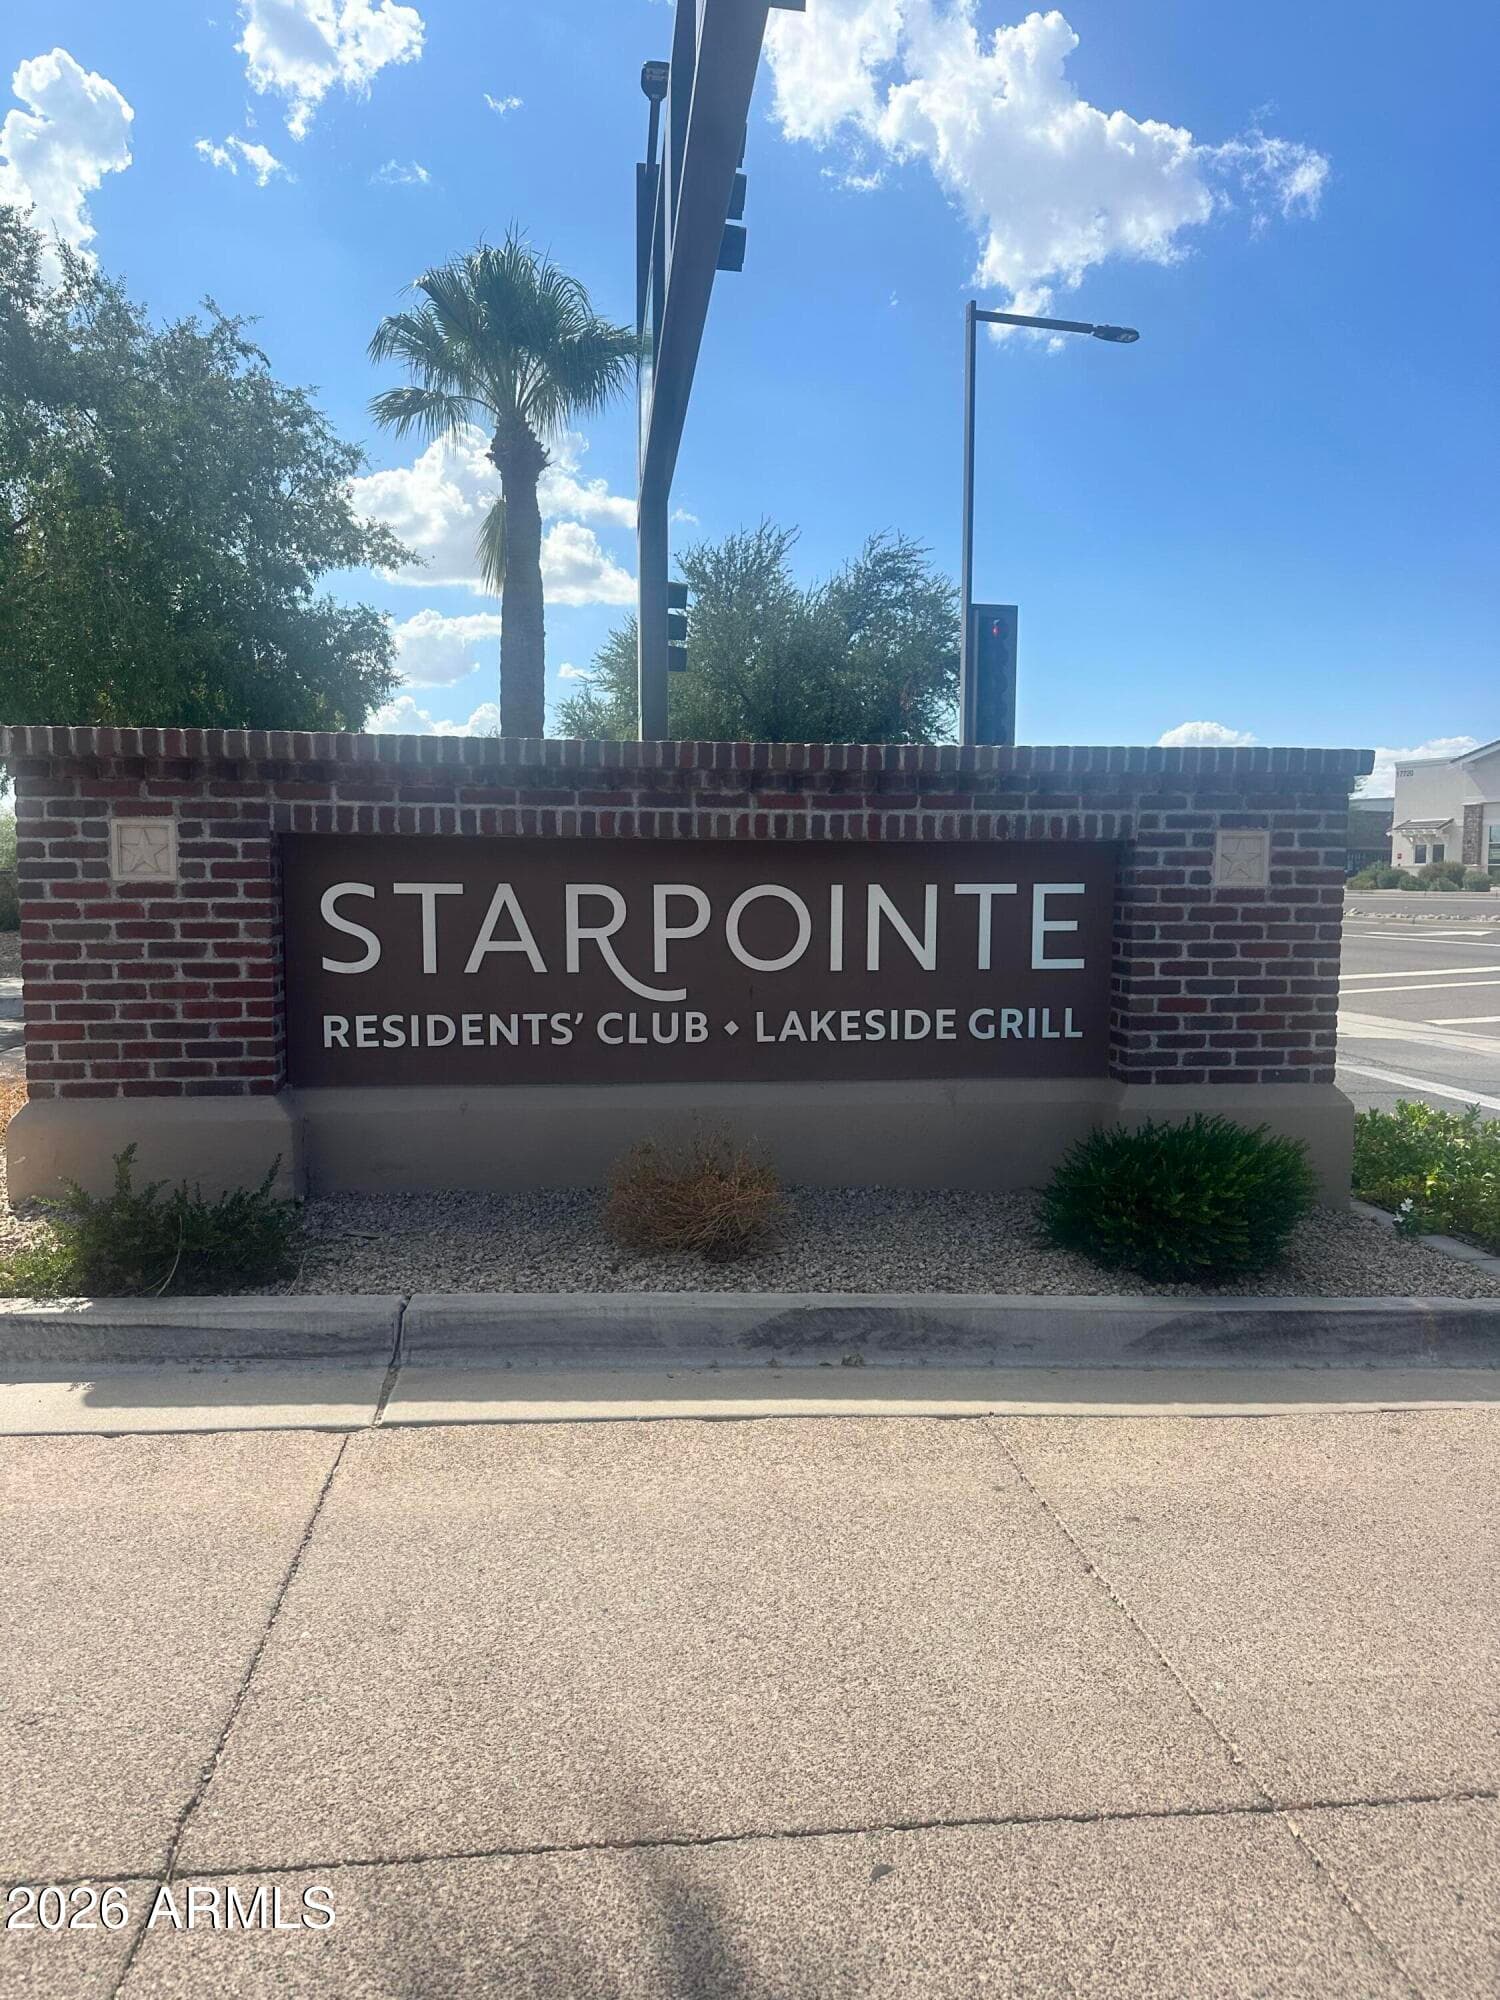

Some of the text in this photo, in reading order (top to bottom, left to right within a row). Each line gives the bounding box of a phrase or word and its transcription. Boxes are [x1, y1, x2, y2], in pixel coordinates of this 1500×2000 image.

[320, 882, 1085, 1001] STARPOINTE
[323, 1007, 1083, 1048] RESIDENTS' CLUB LAKESIDE GRILL
